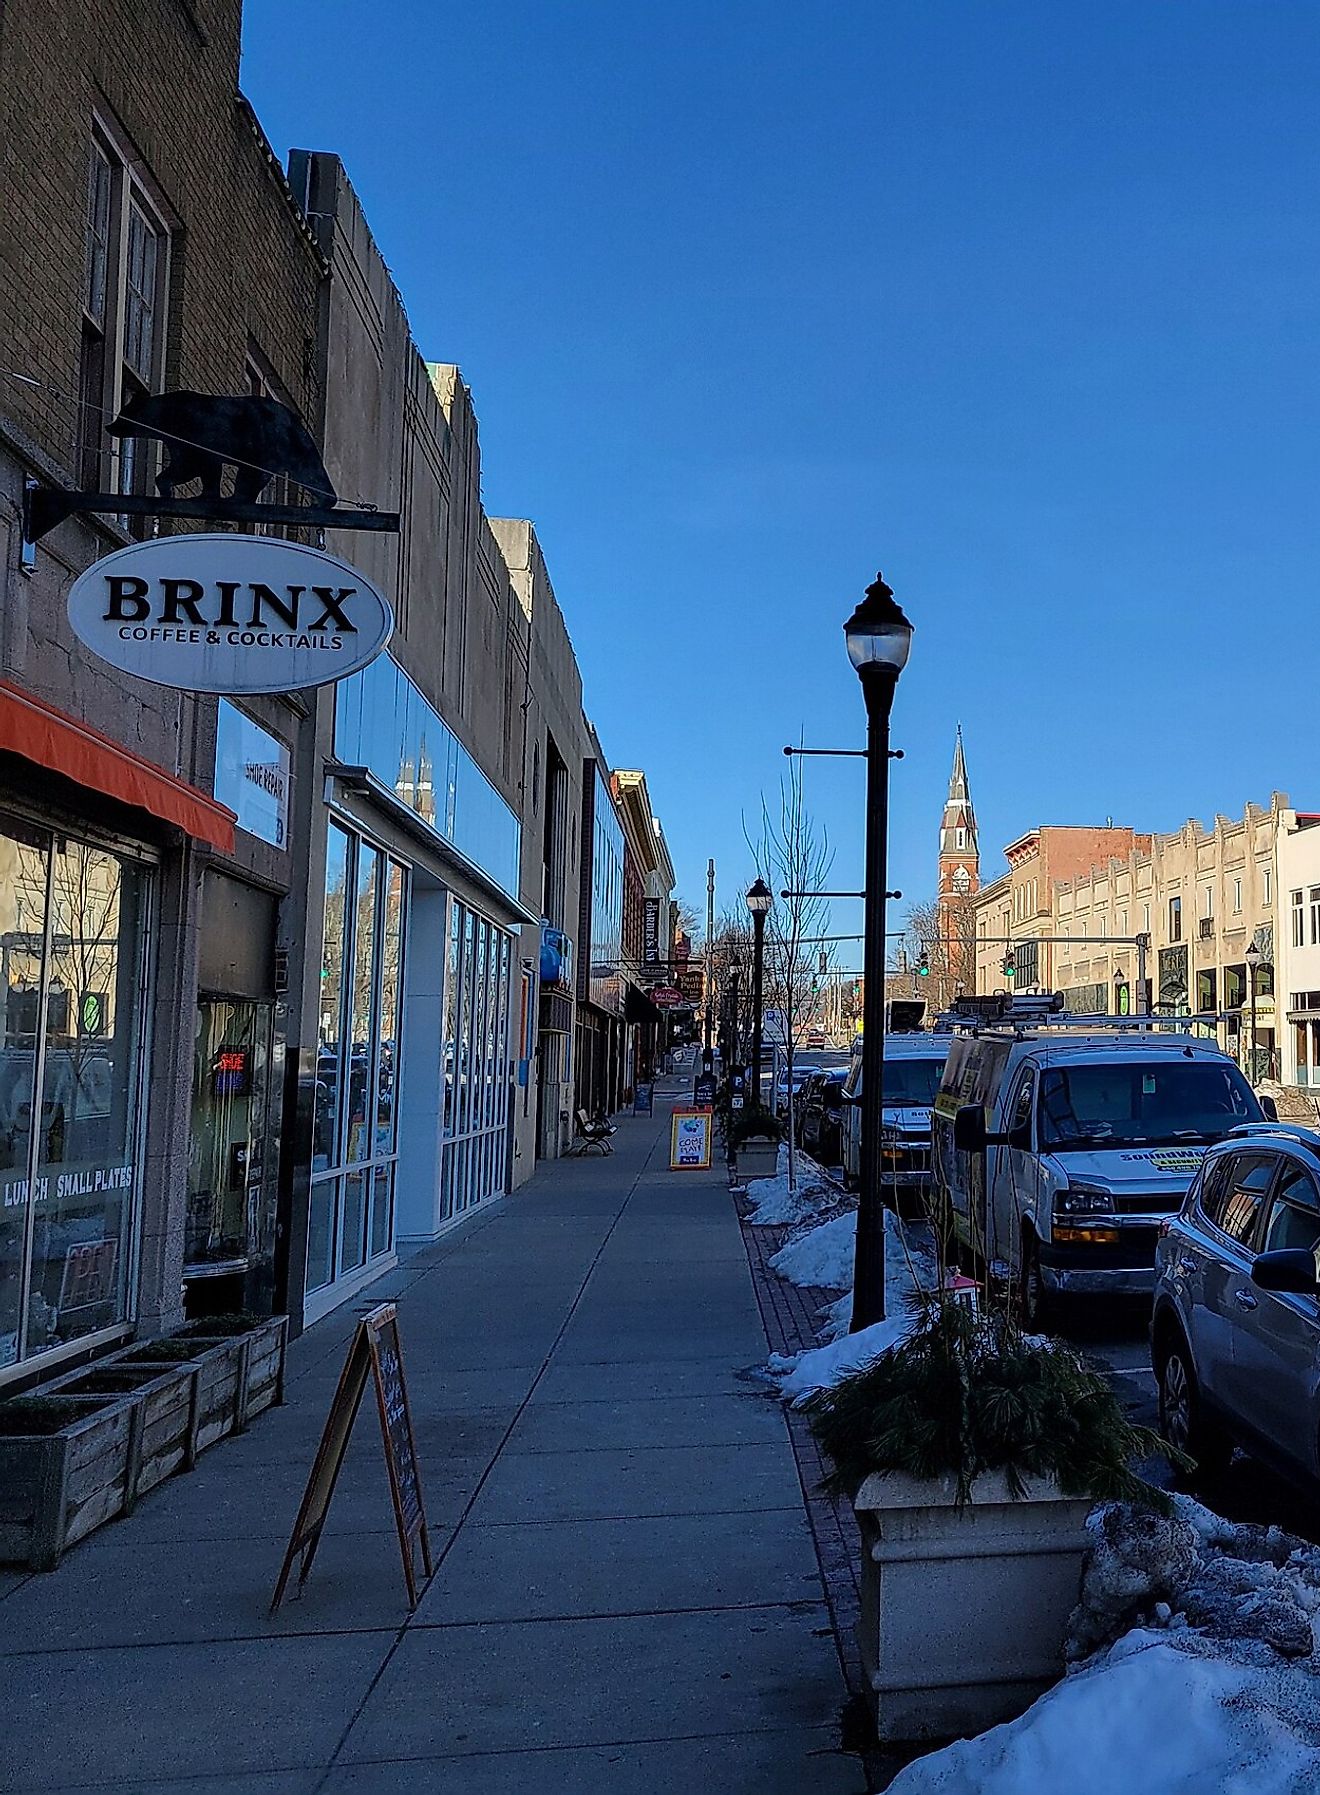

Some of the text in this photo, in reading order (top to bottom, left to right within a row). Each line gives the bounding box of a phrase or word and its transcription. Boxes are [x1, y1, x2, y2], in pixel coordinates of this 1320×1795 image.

[102, 575, 358, 634] BRINX
[118, 625, 344, 651] COFFEE & COCKTAILS
[1120, 1150, 1205, 1161] SoundWo
[4, 1165, 133, 1207] LUNCH SMALL PLATES
